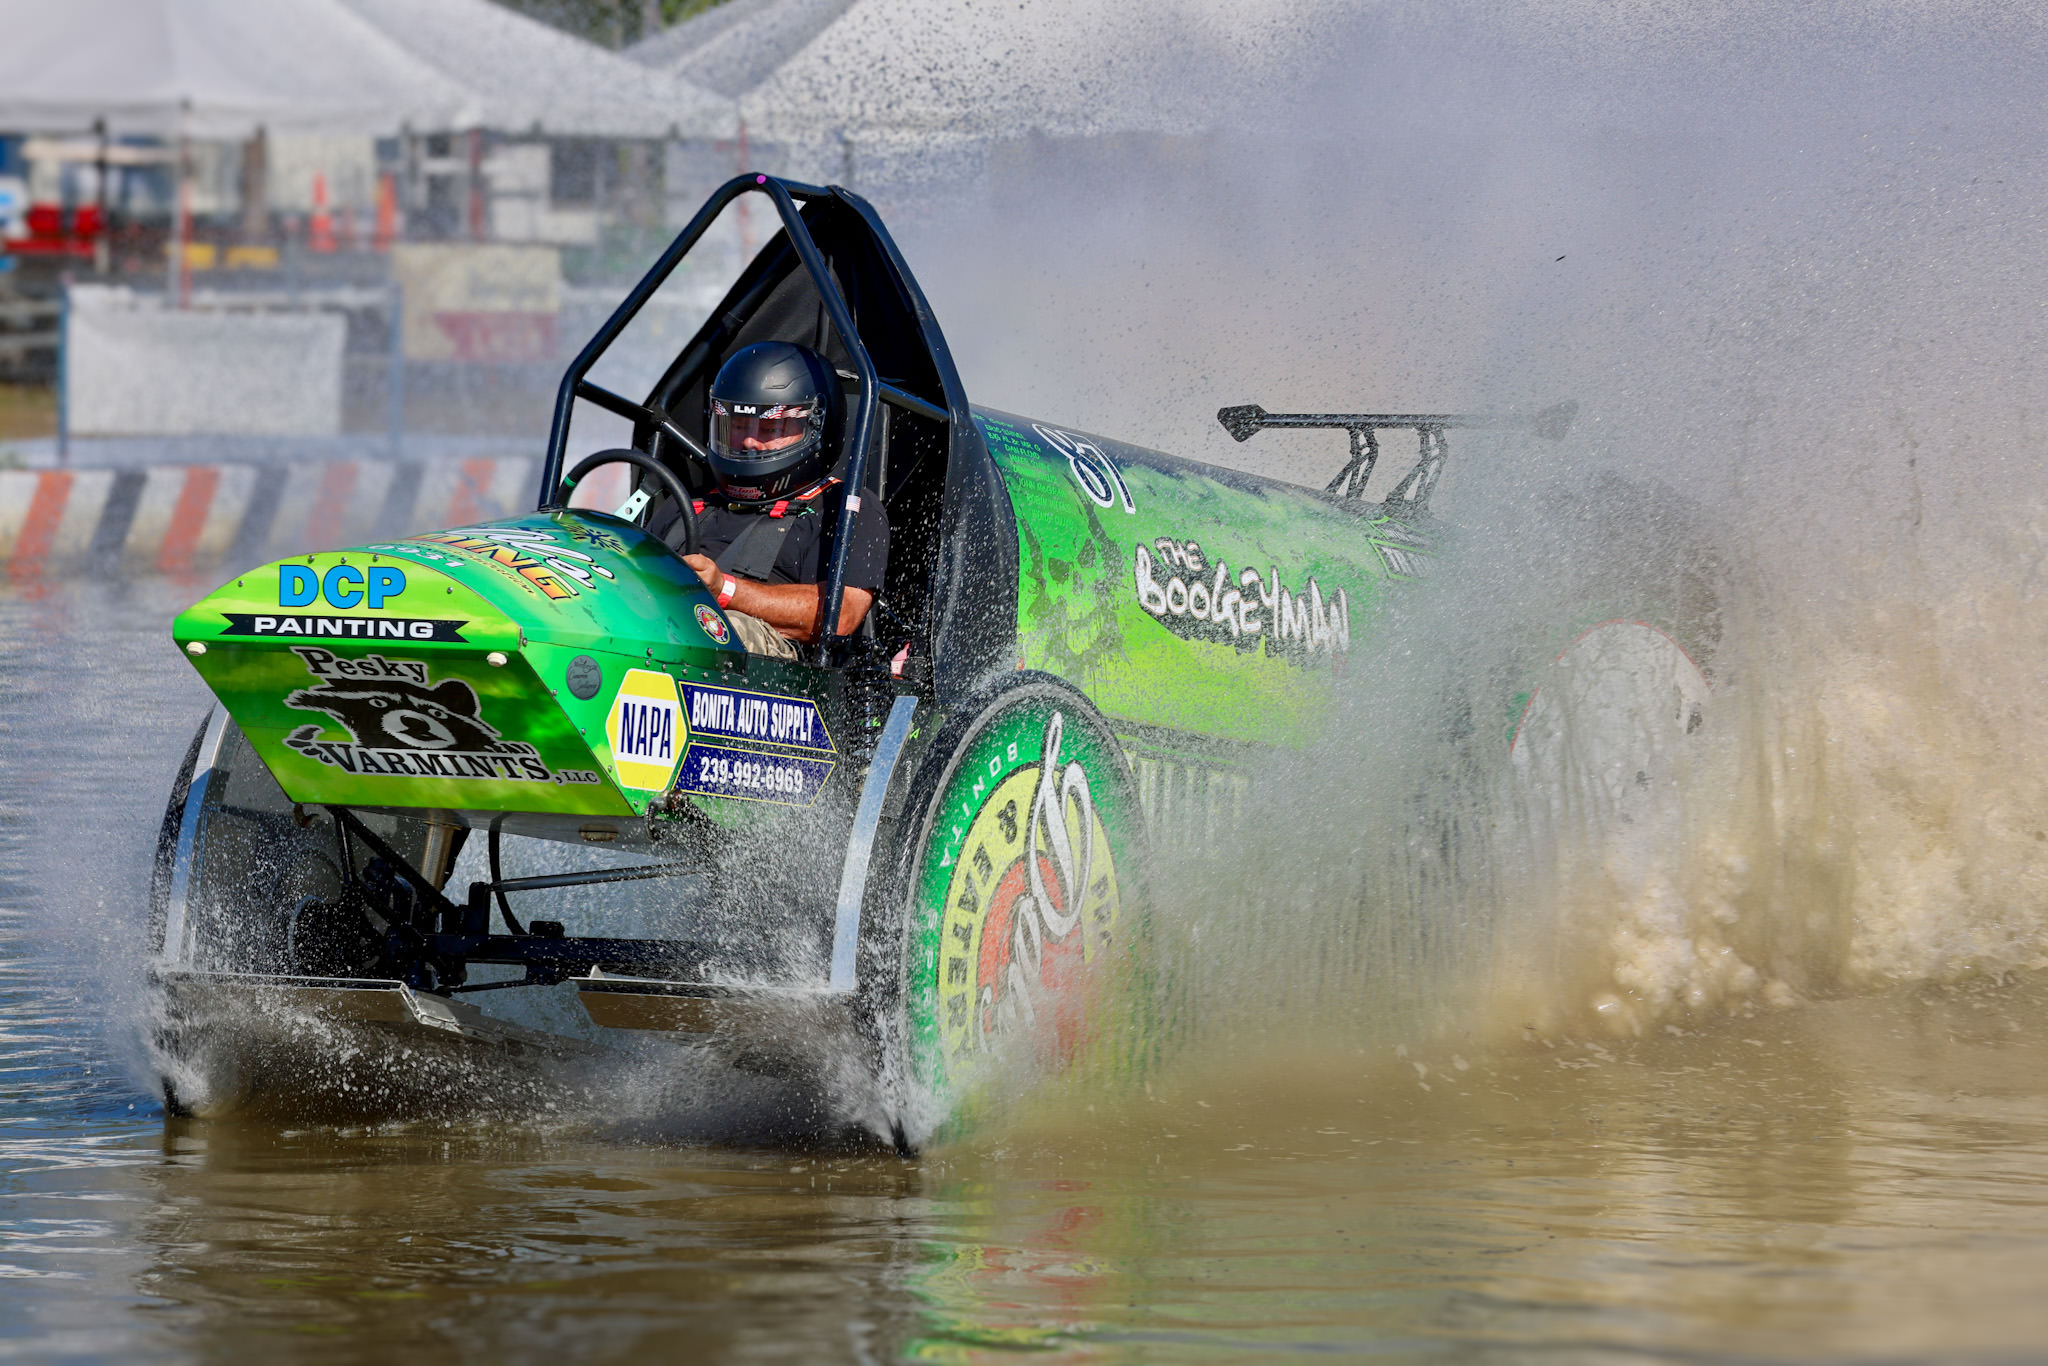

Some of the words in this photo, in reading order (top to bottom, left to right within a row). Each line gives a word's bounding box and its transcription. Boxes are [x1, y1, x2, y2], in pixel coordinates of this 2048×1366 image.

[1156, 540, 1203, 572] THE
[279, 565, 407, 609] DCP
[253, 616, 434, 638] PAINTING
[295, 649, 426, 683] Pesky
[620, 702, 671, 760] NAPA
[692, 691, 735, 732] BONITA
[736, 698, 769, 736] AUTO
[770, 702, 815, 742] SUPPLY
[564, 771, 599, 784] LLC
[700, 756, 804, 794] 239-992-6969
